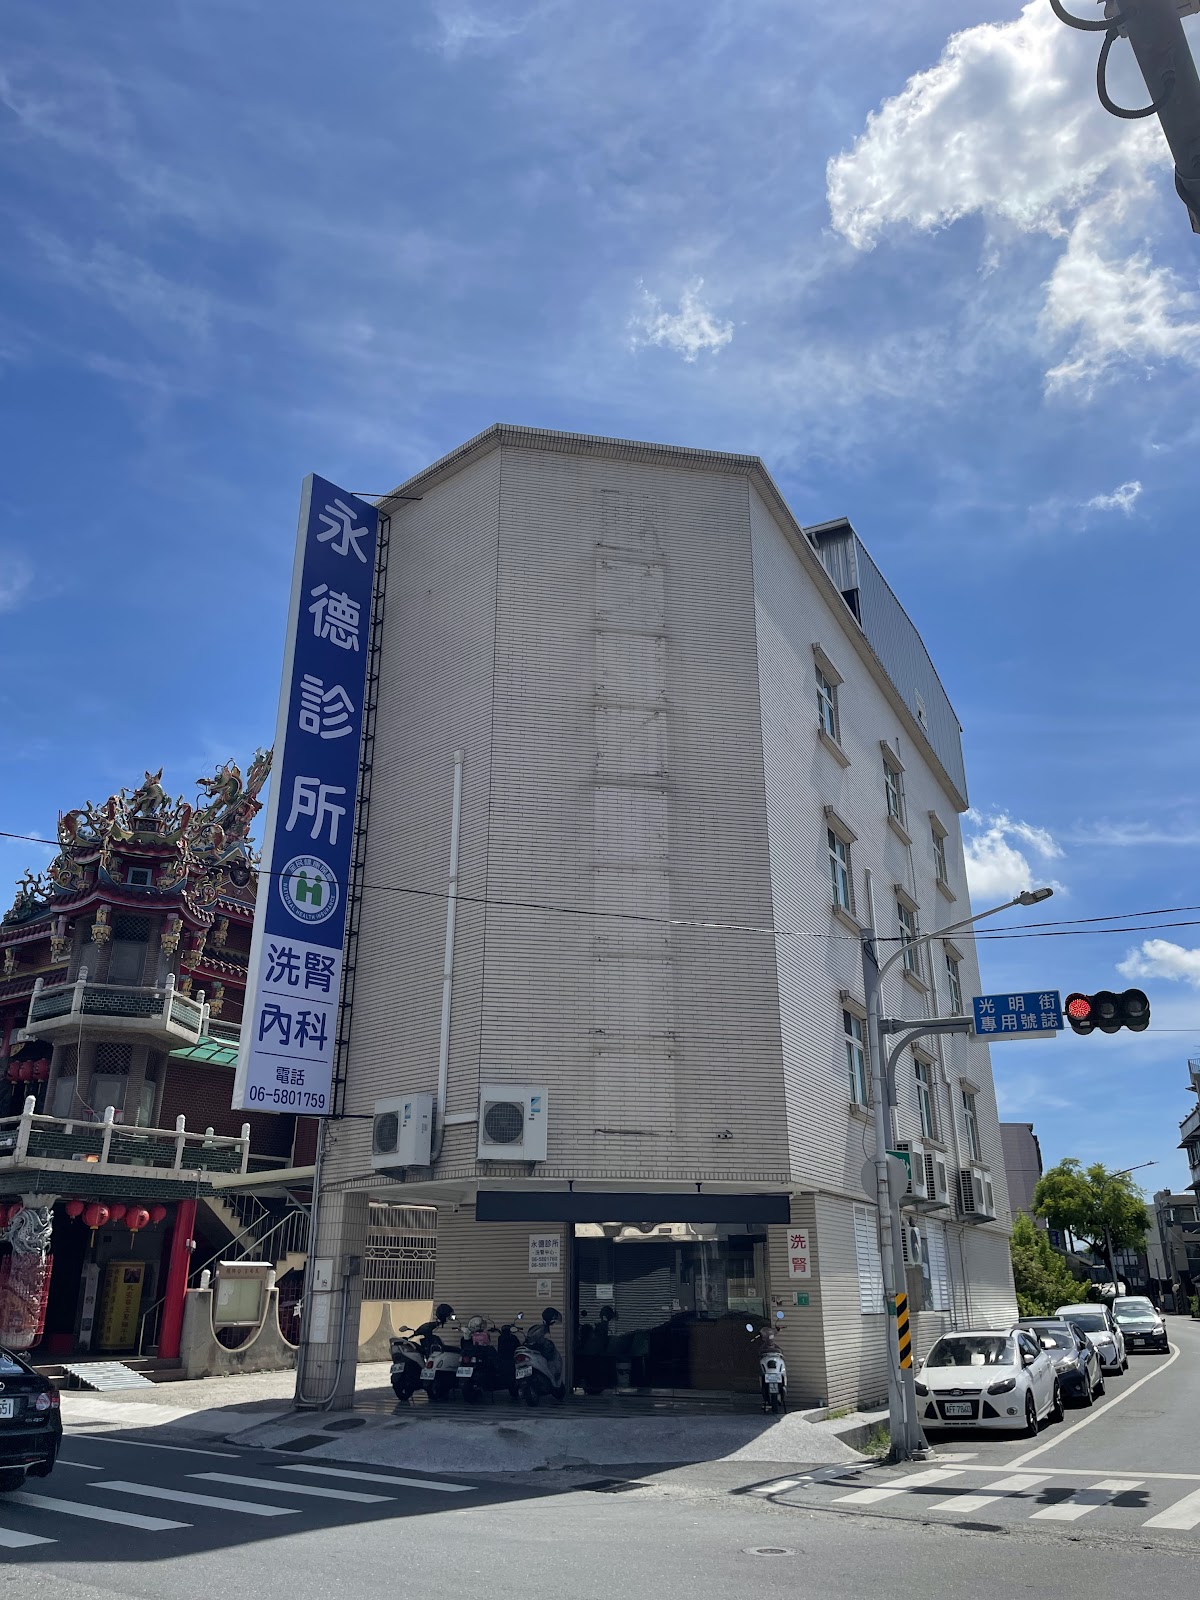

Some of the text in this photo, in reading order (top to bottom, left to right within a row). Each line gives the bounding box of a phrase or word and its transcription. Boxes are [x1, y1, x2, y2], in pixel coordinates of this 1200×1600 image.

[286, 498, 369, 845] 永德診所
[265, 943, 336, 993] 洗腎
[979, 993, 1055, 1015] 光明街
[980, 1011, 1059, 1032] 專用號誌
[275, 1066, 305, 1087] 電話
[250, 1085, 325, 1109] 06-5801759
[790, 1234, 807, 1272] 洗腎
